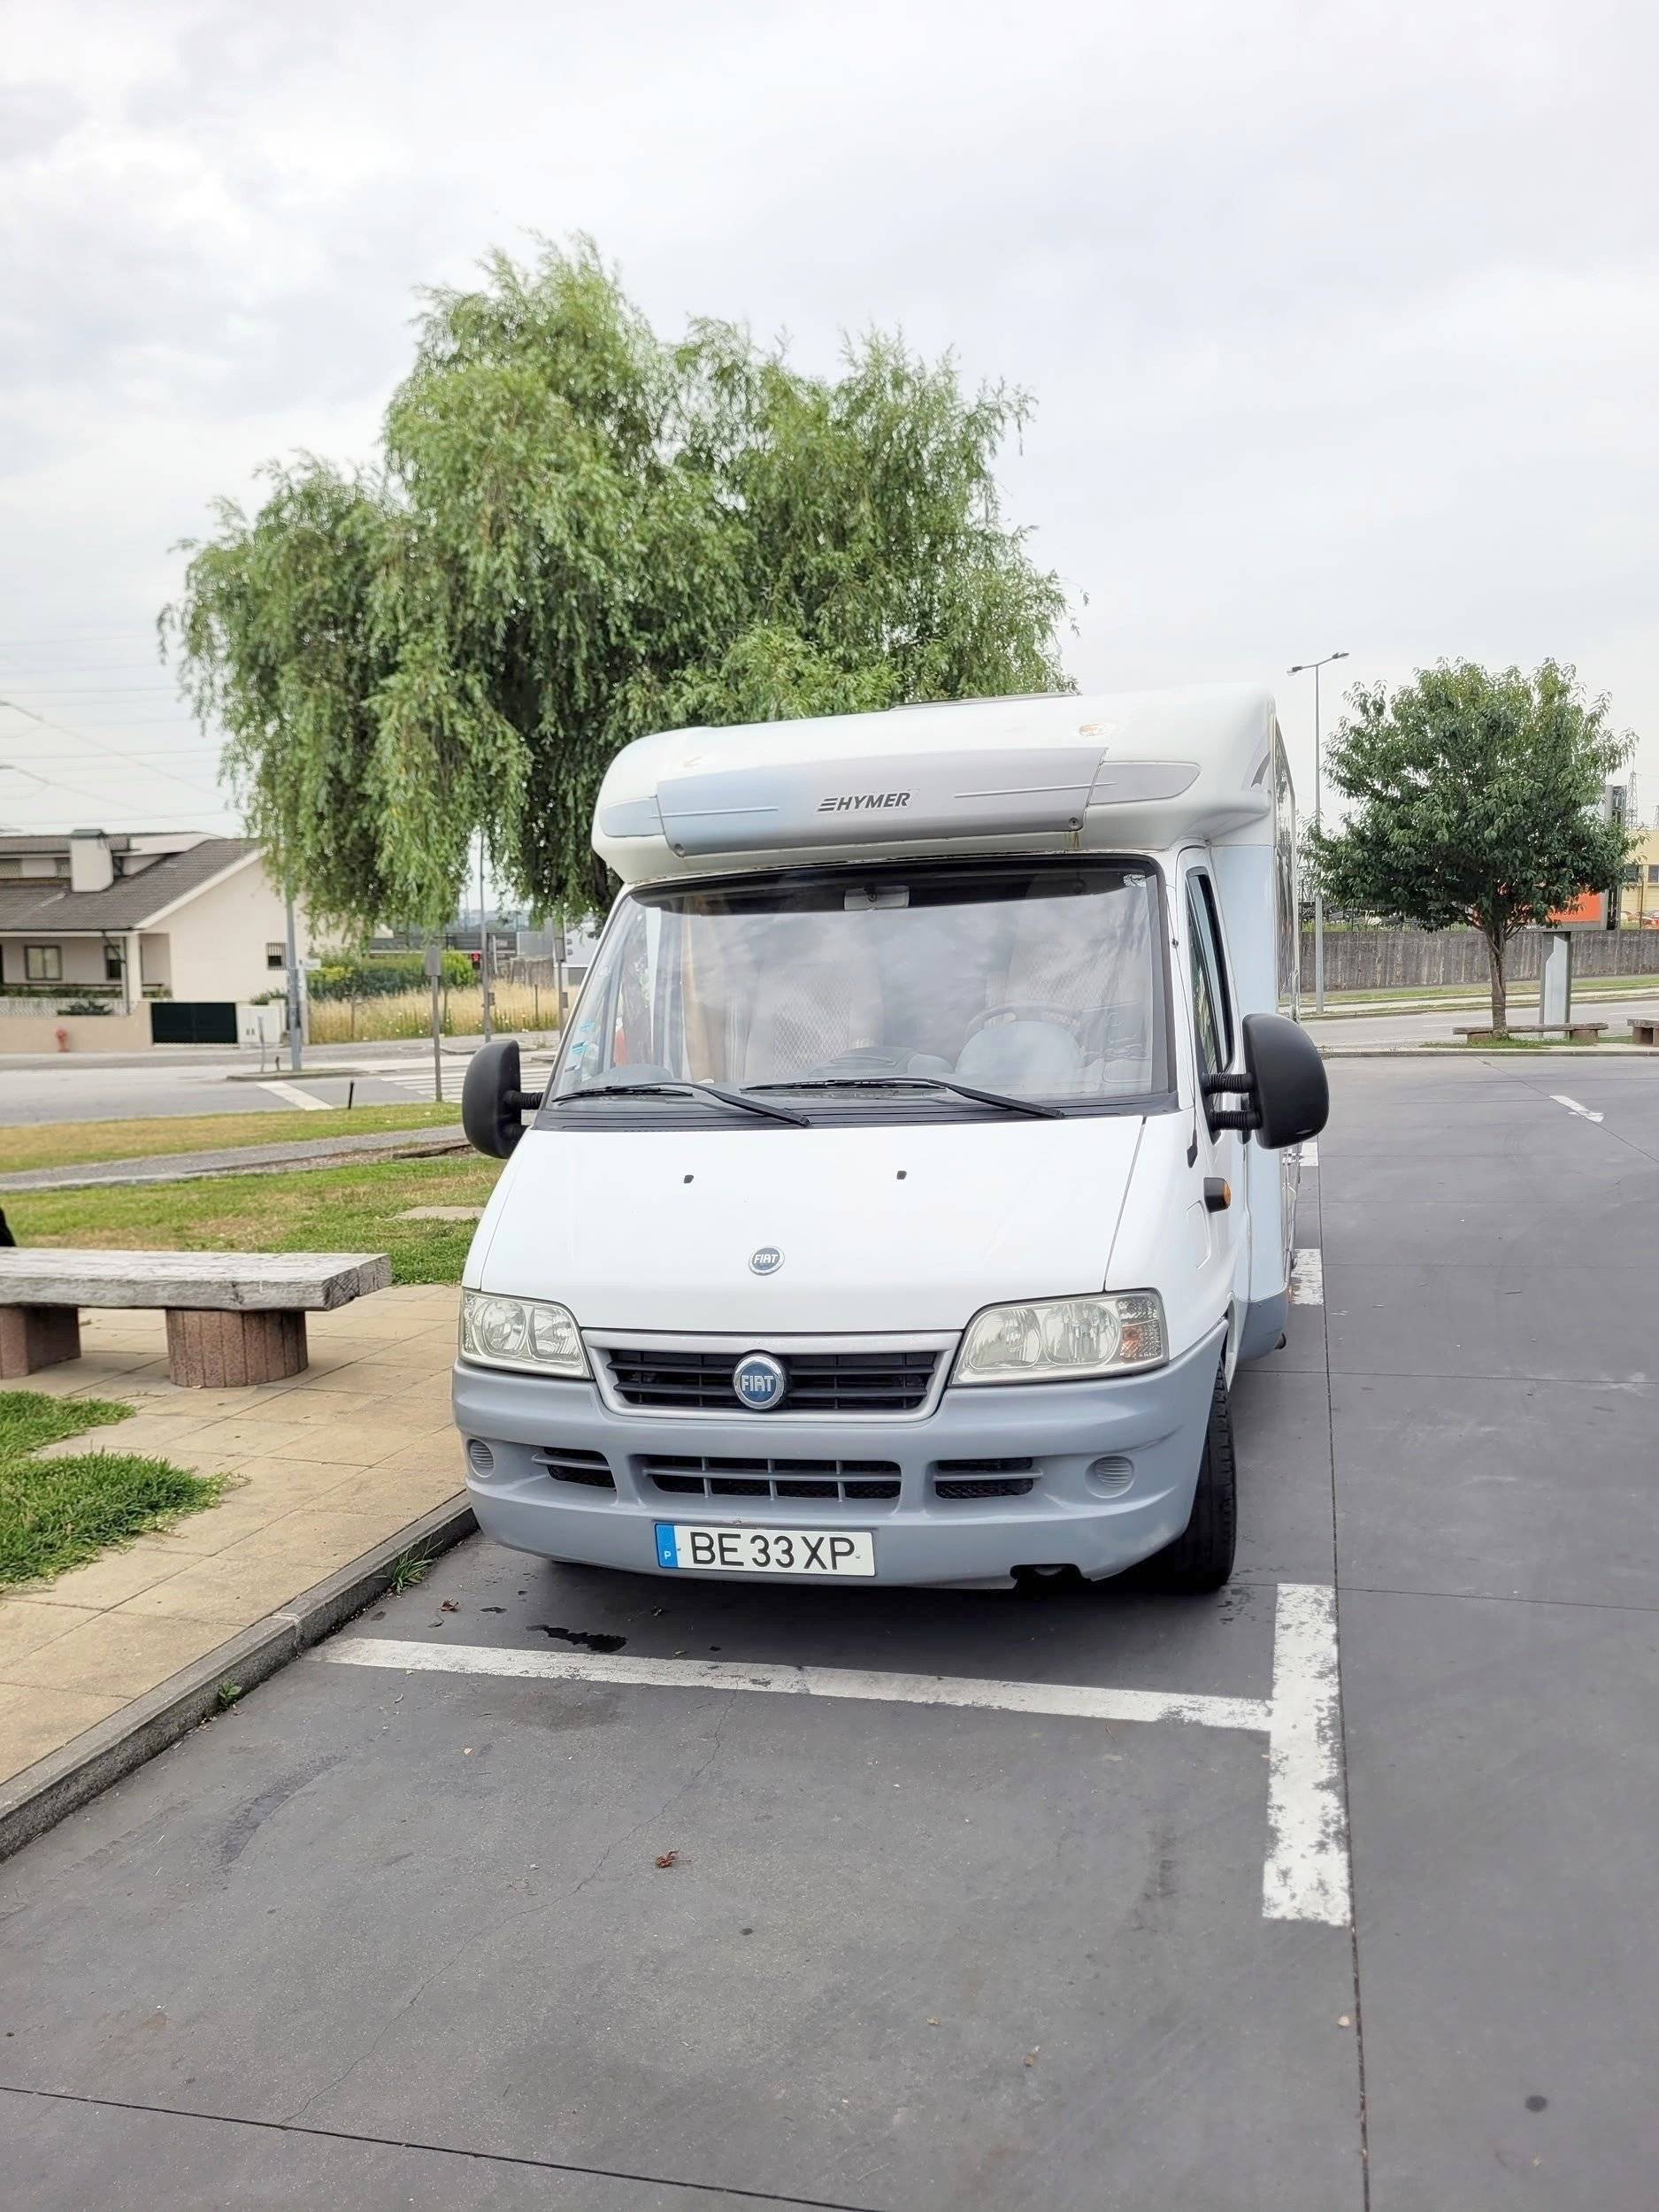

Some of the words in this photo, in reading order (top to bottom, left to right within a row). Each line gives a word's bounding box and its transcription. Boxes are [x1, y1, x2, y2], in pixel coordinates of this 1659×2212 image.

[753, 1253, 779, 1264] FIAT
[741, 1374, 774, 1392] FIAT
[664, 1550, 672, 1560] P
